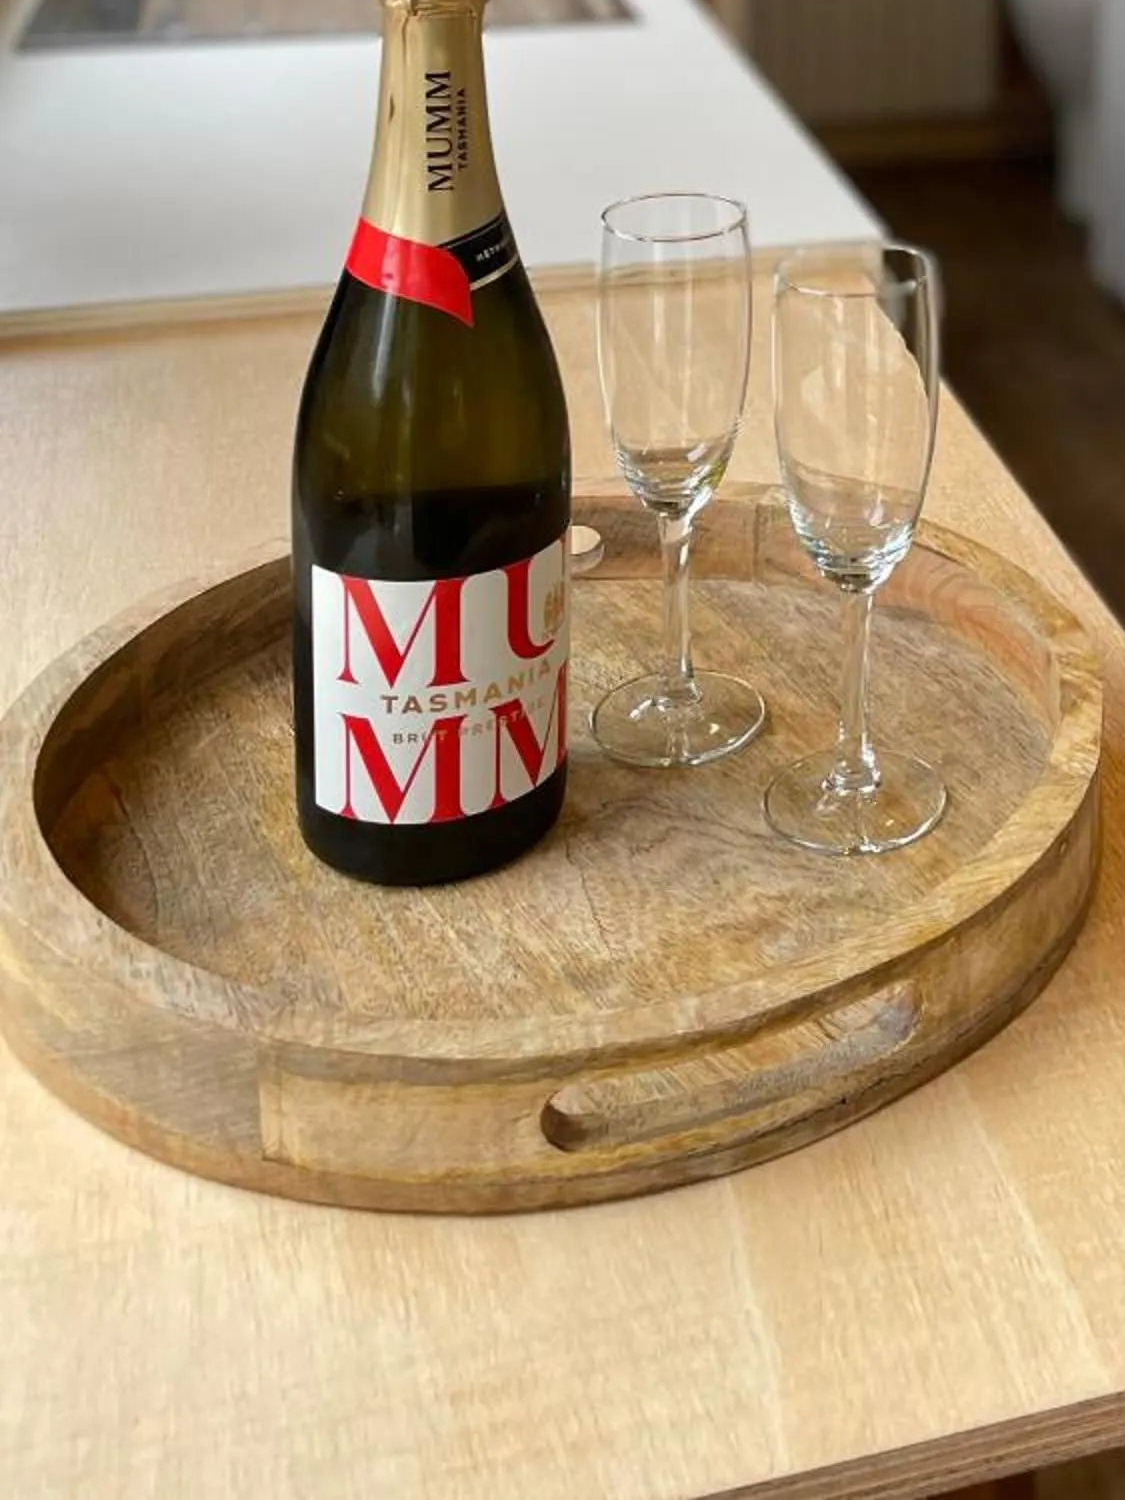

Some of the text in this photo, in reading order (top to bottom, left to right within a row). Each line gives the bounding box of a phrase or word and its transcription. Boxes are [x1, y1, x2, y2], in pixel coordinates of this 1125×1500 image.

[425, 71, 455, 192] MUMM
[457, 88, 468, 171] TASMANIA
[380, 657, 551, 713] TASMANIA
